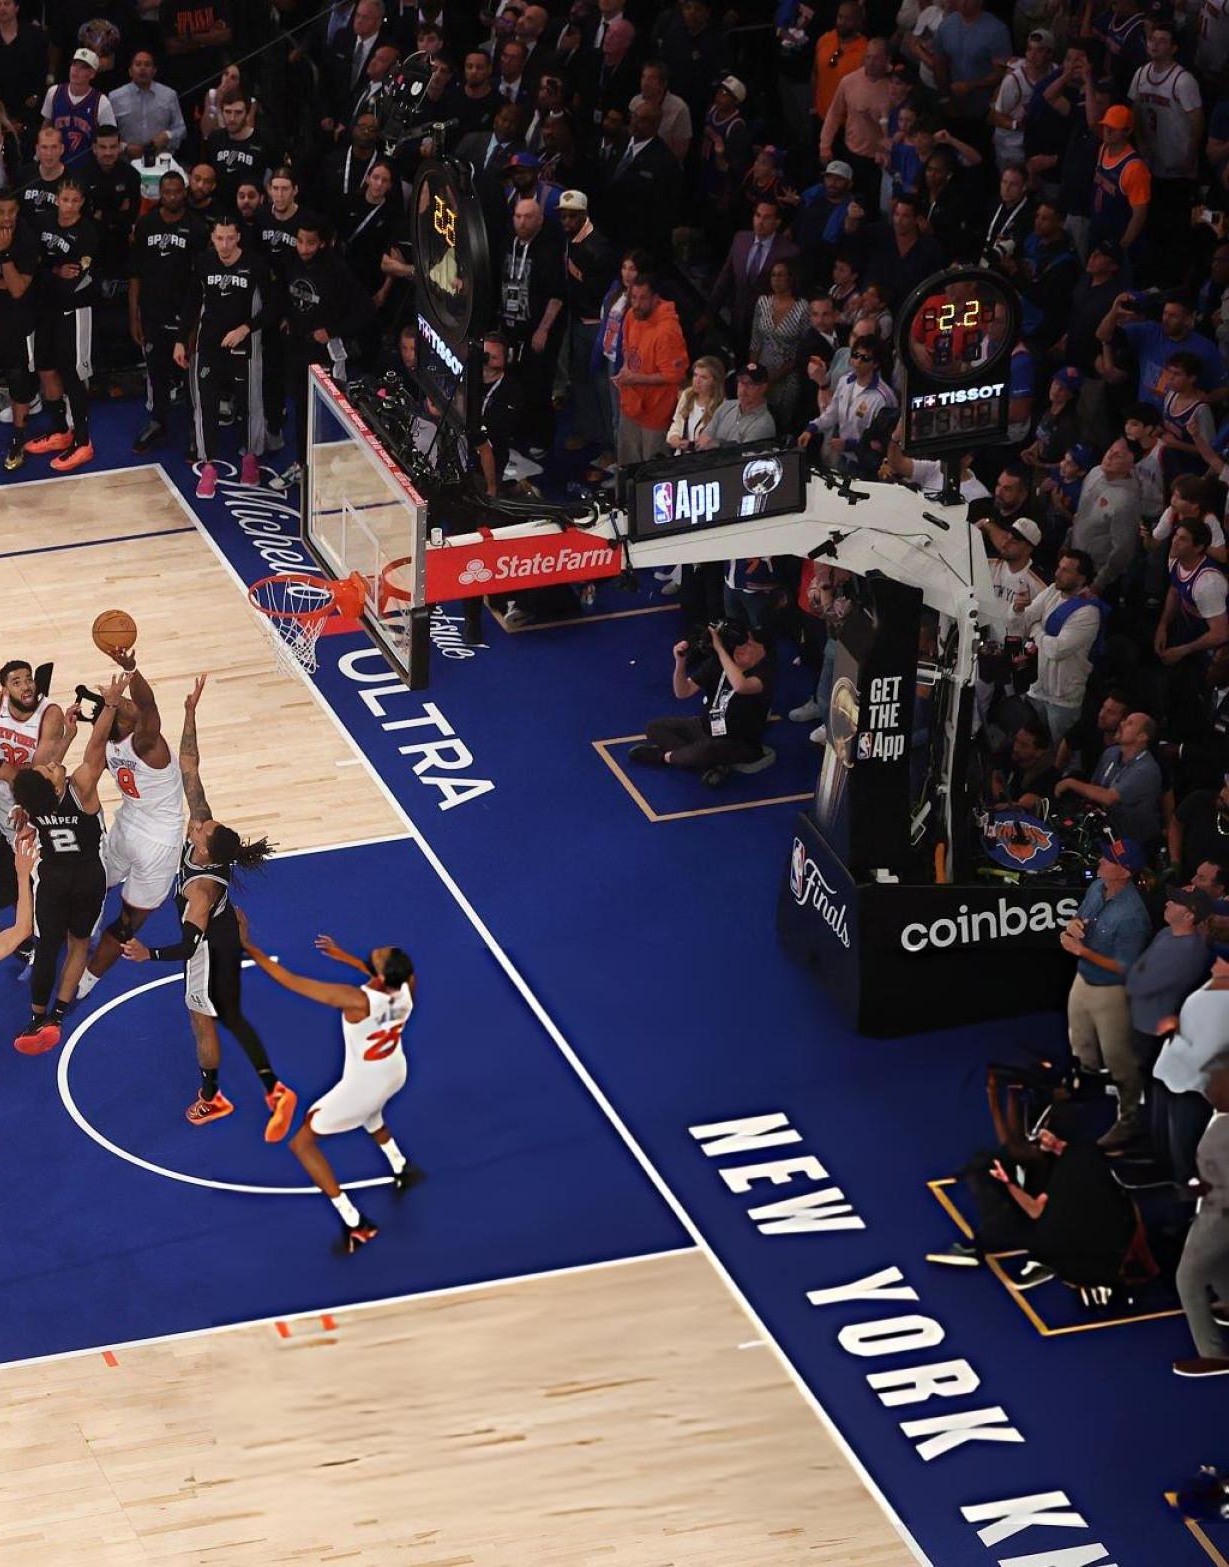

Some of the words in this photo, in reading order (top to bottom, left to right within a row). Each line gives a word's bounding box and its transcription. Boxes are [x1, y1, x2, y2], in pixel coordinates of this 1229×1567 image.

[147, 233, 186, 249] SPURS
[207, 274, 248, 289] SPURS
[939, 300, 980, 331] 2.2
[938, 383, 1005, 406] TISSOT
[675, 479, 720, 524] App
[870, 676, 902, 703] GET
[337, 647, 496, 811] ULTRA
[869, 703, 900, 729] THE
[0, 742, 30, 766] 32
[872, 731, 904, 762] App
[117, 767, 141, 799] 8
[36, 815, 79, 825] HARPER
[49, 828, 81, 852] 2
[795, 858, 850, 948] Finals
[901, 898, 1079, 953] coinbas
[688, 1112, 866, 1235] NEW
[806, 1266, 1026, 1462] YORK
